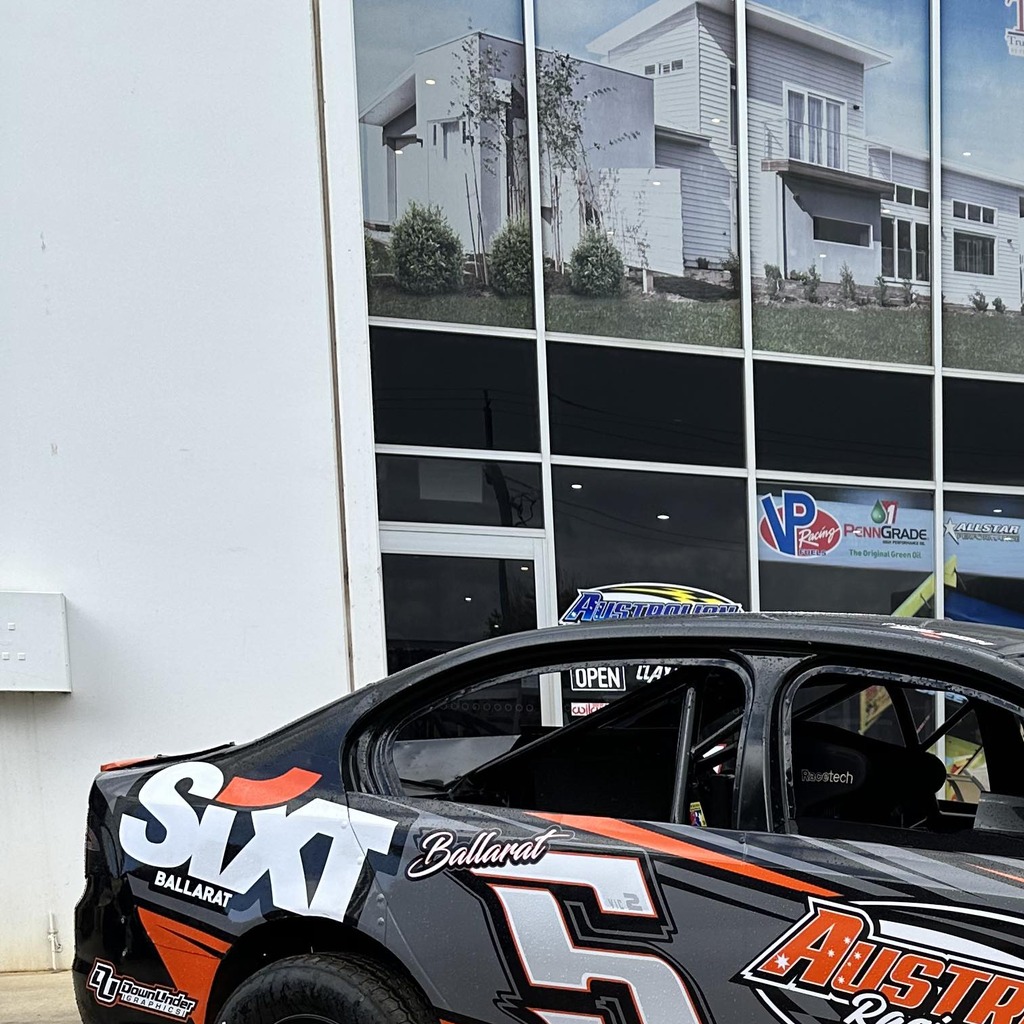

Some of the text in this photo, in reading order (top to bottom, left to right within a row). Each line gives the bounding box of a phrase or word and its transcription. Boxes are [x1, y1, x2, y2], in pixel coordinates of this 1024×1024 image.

[761, 491, 816, 557] VP
[956, 522, 1020, 535] ALLSTAR
[799, 525, 842, 549] Racing
[849, 549, 922, 560] The Original Green Oil
[574, 666, 622, 689] OPEN
[801, 768, 853, 784] Racetech
[406, 828, 572, 879] Ballarat
[154, 871, 233, 909] BALLARAT
[623, 892, 643, 911] 2
[125, 994, 184, 1015] GRAPHICS
